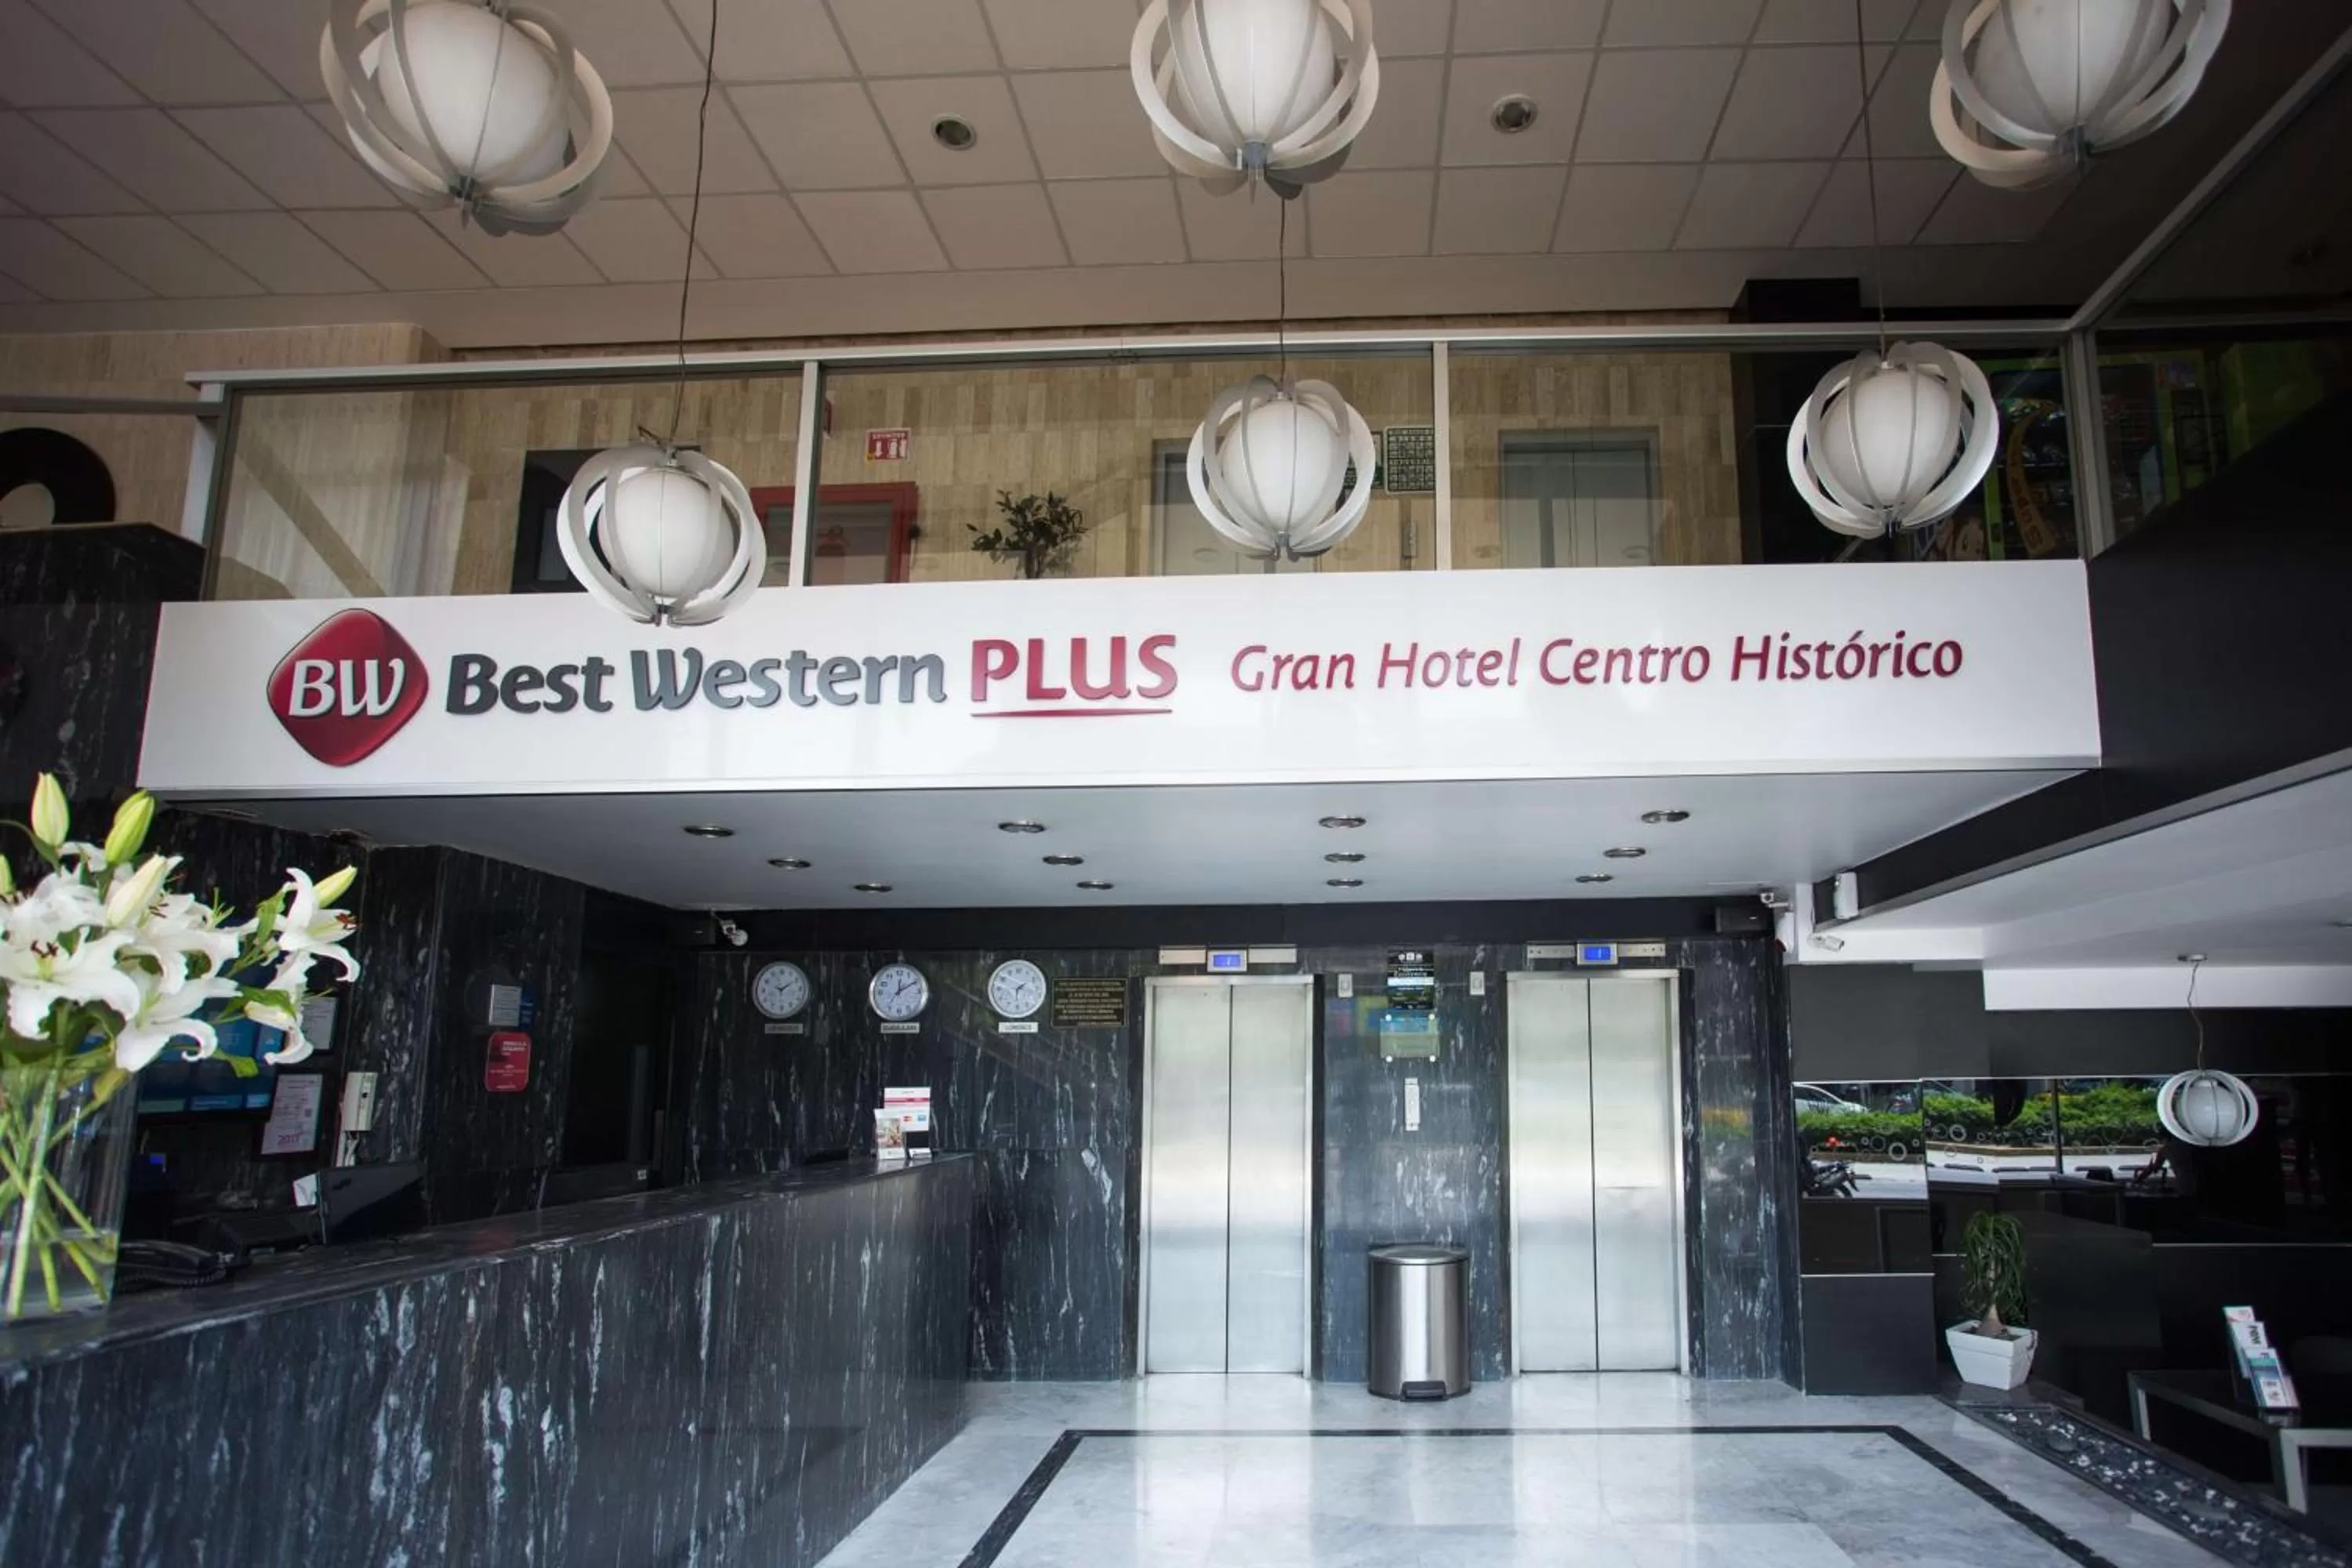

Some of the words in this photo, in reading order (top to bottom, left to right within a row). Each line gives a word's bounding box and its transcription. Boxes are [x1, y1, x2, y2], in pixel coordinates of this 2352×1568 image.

[288, 659, 405, 718] BW
[445, 653, 615, 714] Best
[630, 648, 947, 711] Western
[971, 634, 1178, 702] PLUS
[1231, 644, 1355, 691] Gran
[1377, 637, 1522, 688] Hotel
[1539, 637, 1711, 685] Centro
[1730, 630, 1964, 681] Histórico
